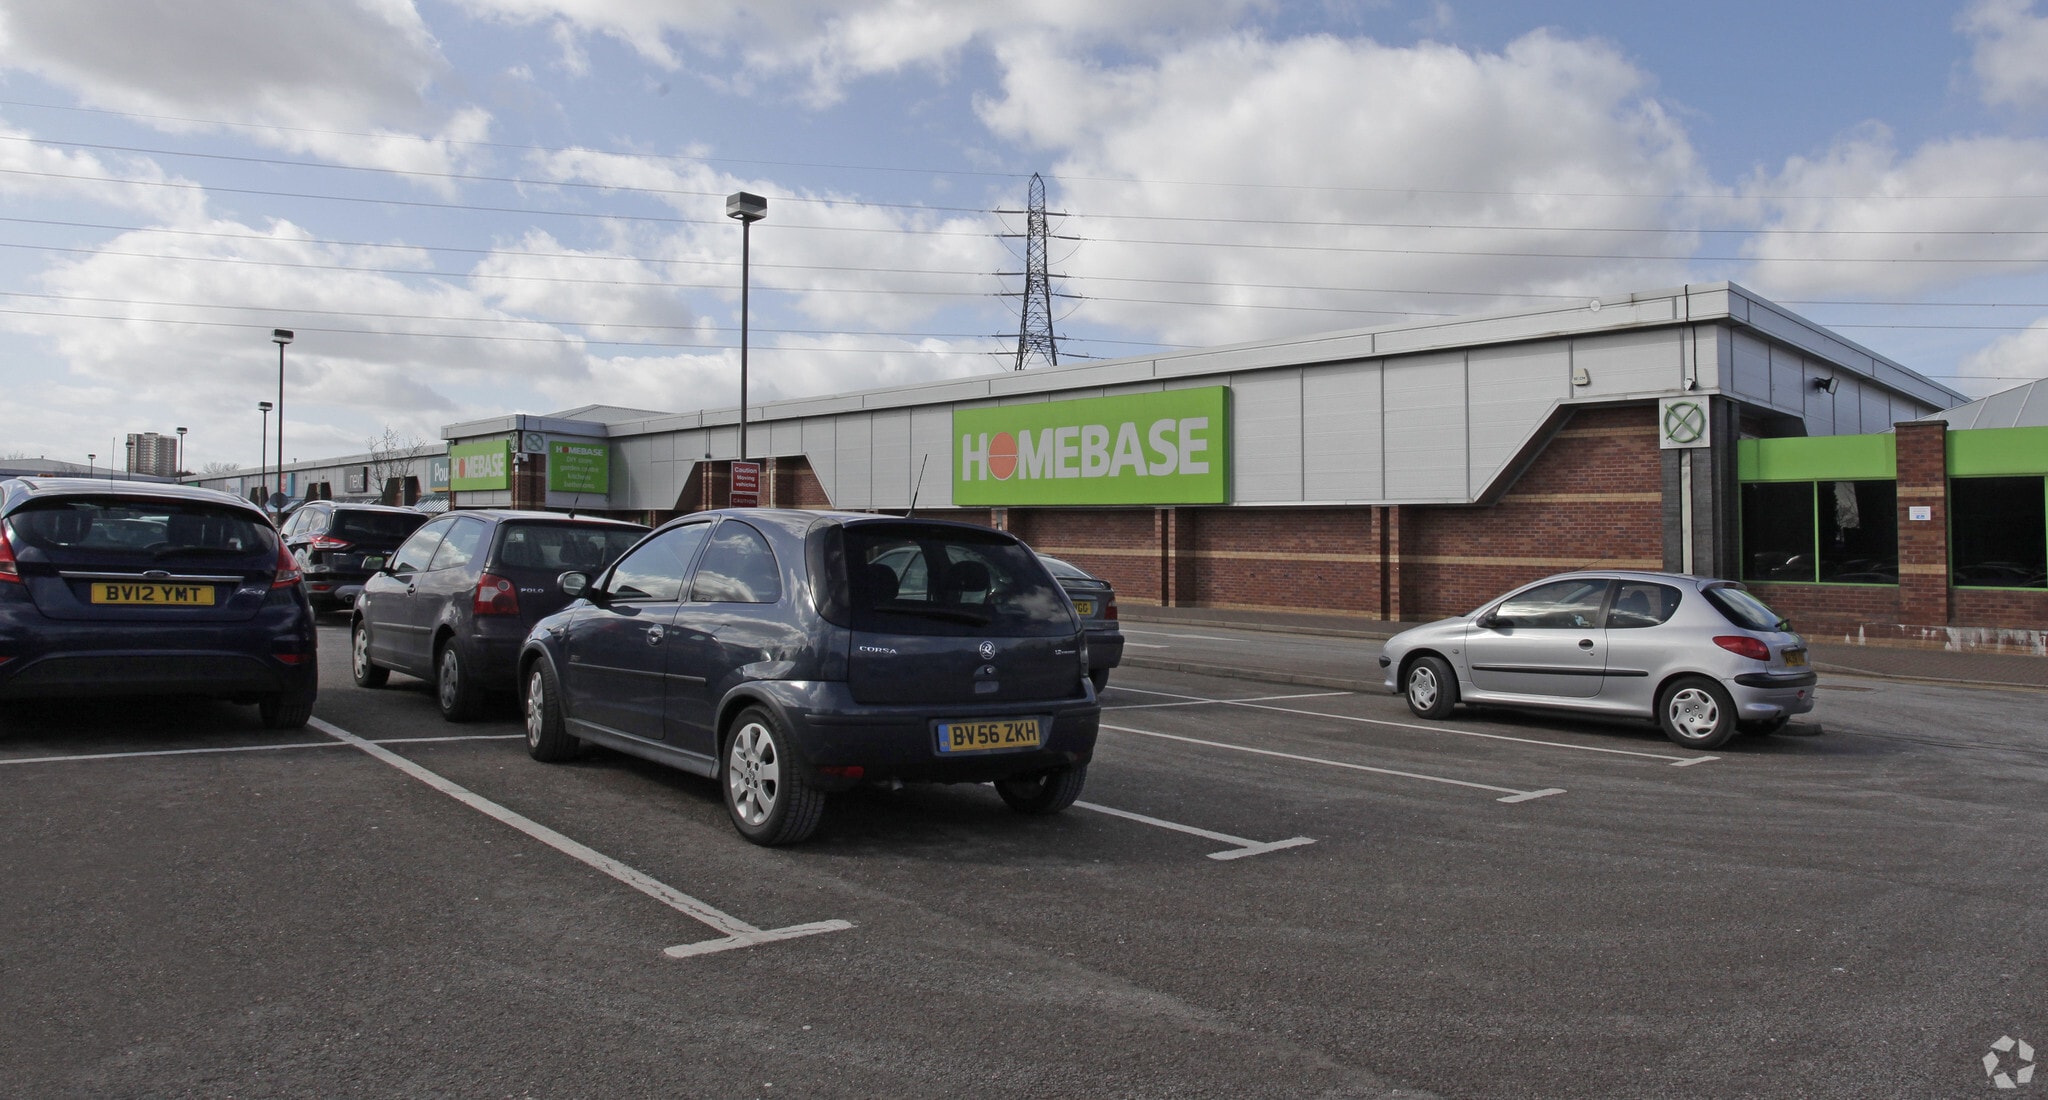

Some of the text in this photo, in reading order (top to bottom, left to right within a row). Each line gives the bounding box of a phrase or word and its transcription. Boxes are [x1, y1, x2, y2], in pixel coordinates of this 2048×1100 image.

[556, 445, 603, 456] HOMEBASE
[962, 417, 1208, 480] HOMEBASE
[452, 453, 504, 479] HOMEBASE
[106, 585, 201, 602] BV12 YMT
[859, 645, 897, 654] CORSA
[952, 722, 1037, 746] BV56 ZKH
